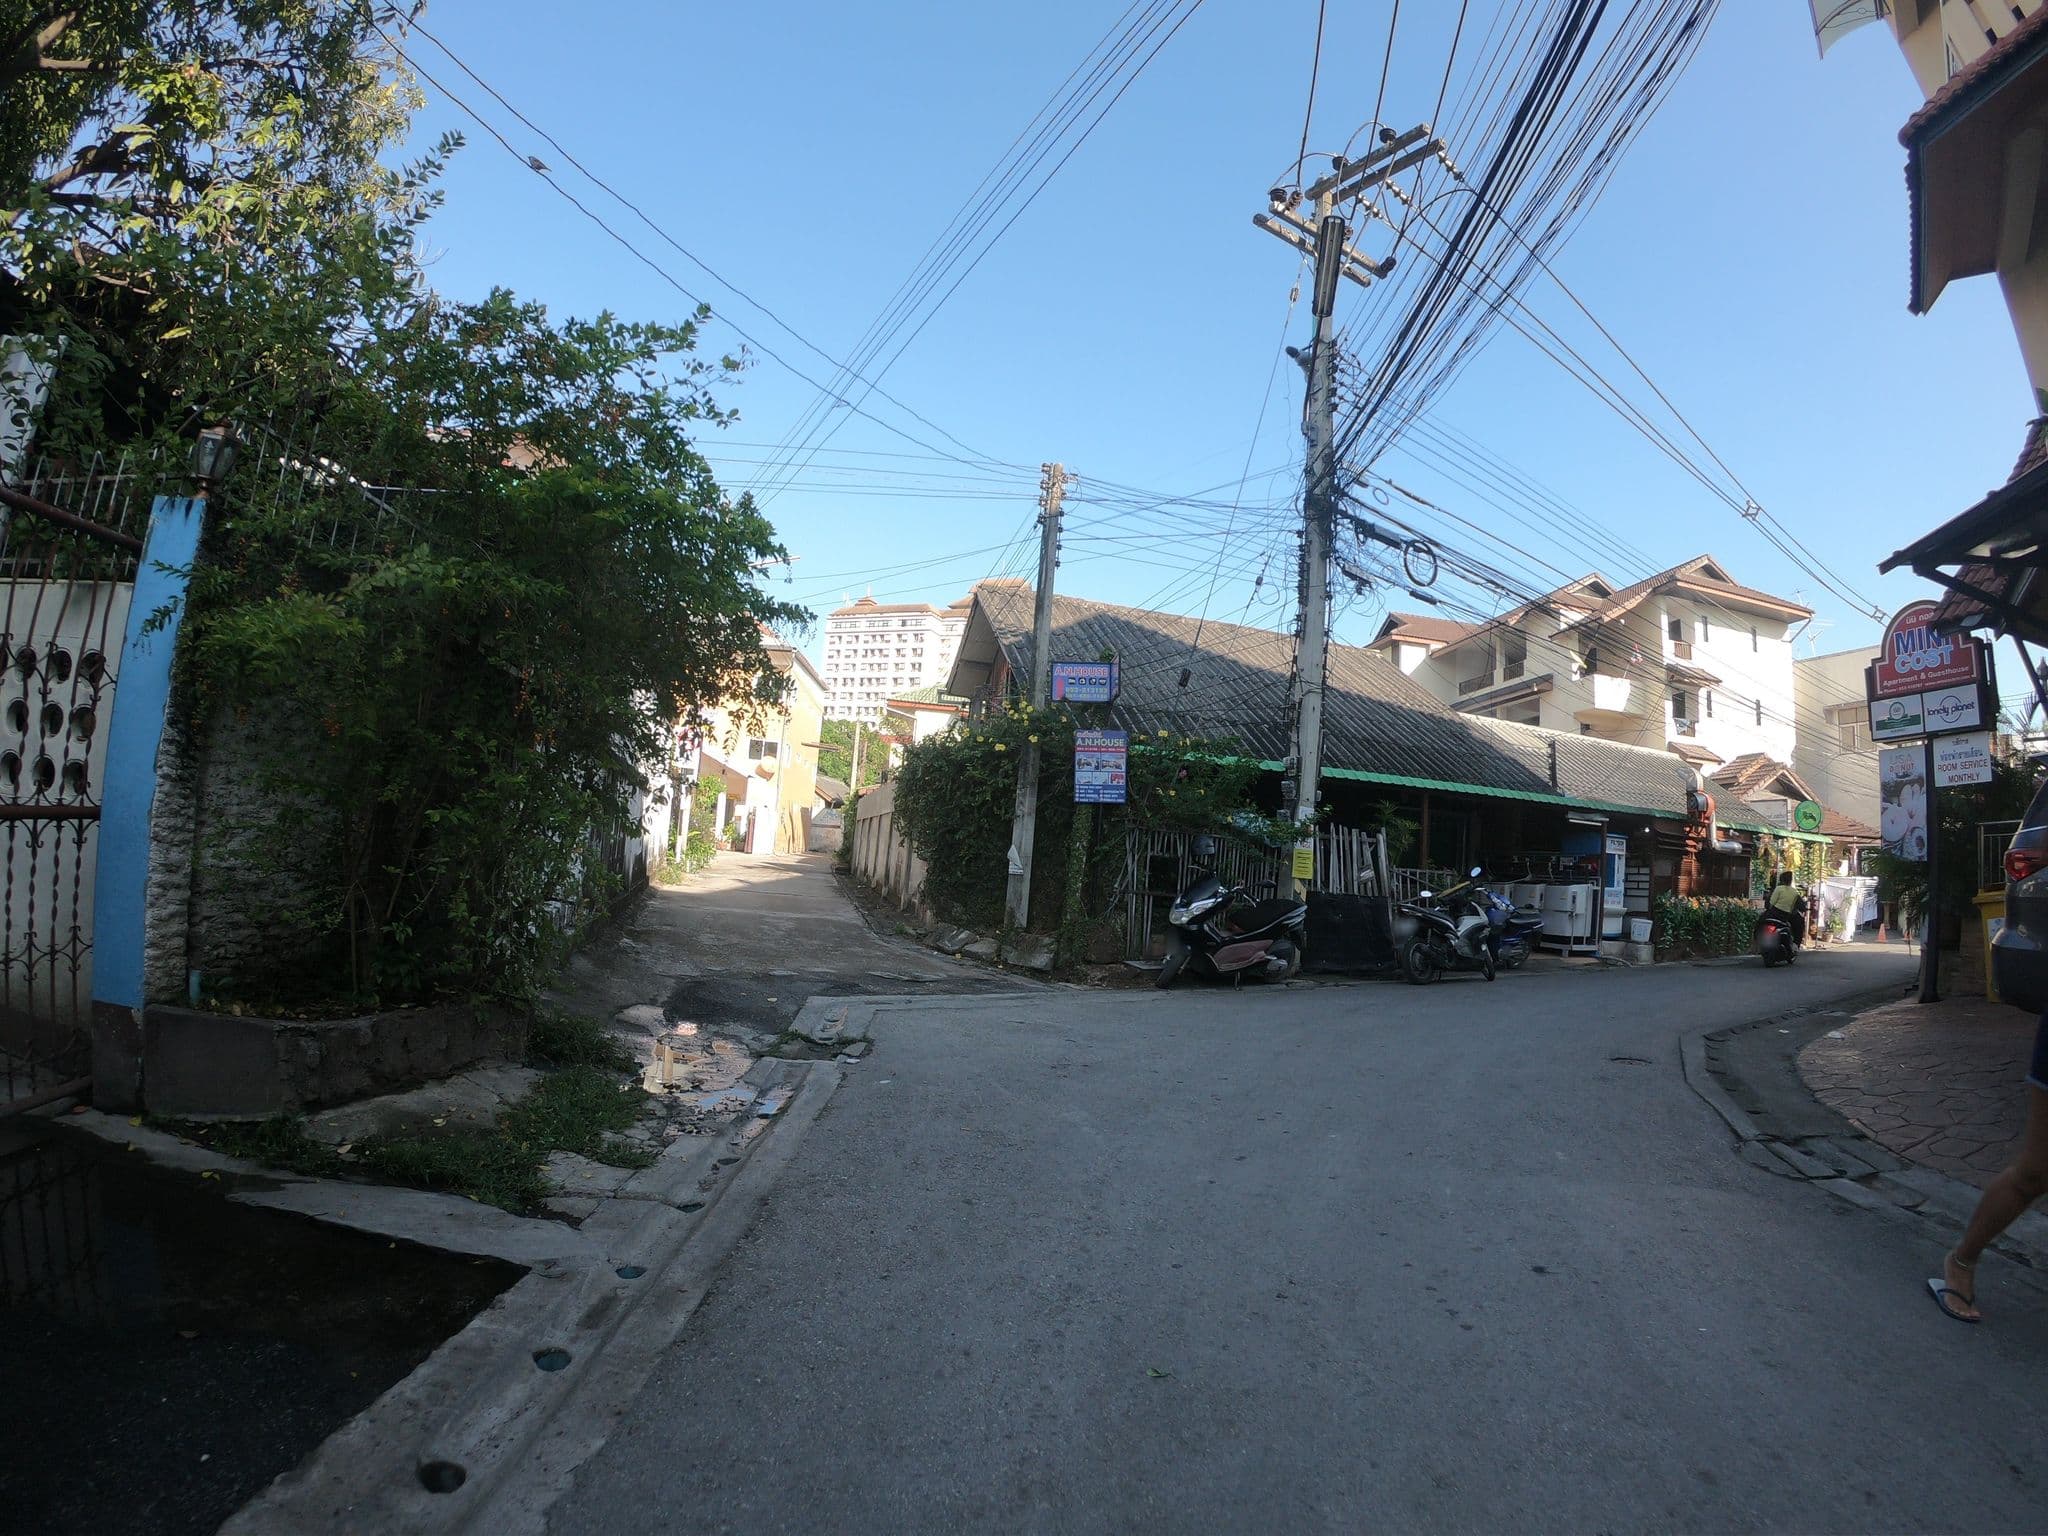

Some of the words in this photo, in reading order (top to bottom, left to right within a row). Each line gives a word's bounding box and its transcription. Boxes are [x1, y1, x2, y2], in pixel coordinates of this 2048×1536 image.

[1894, 645, 1954, 673] COST
[1882, 675, 1918, 687] Apartment
[1920, 672, 1926, 680] &
[1927, 666, 1969, 678] Guesthouse
[1927, 704, 1950, 716] lonely
[1950, 701, 1975, 715] planet
[1076, 738, 1124, 747] A.N.HOUSE
[1938, 762, 1957, 772] ROOM
[1960, 758, 1988, 770] SERVICE
[1948, 772, 1980, 783] MONTHLY
